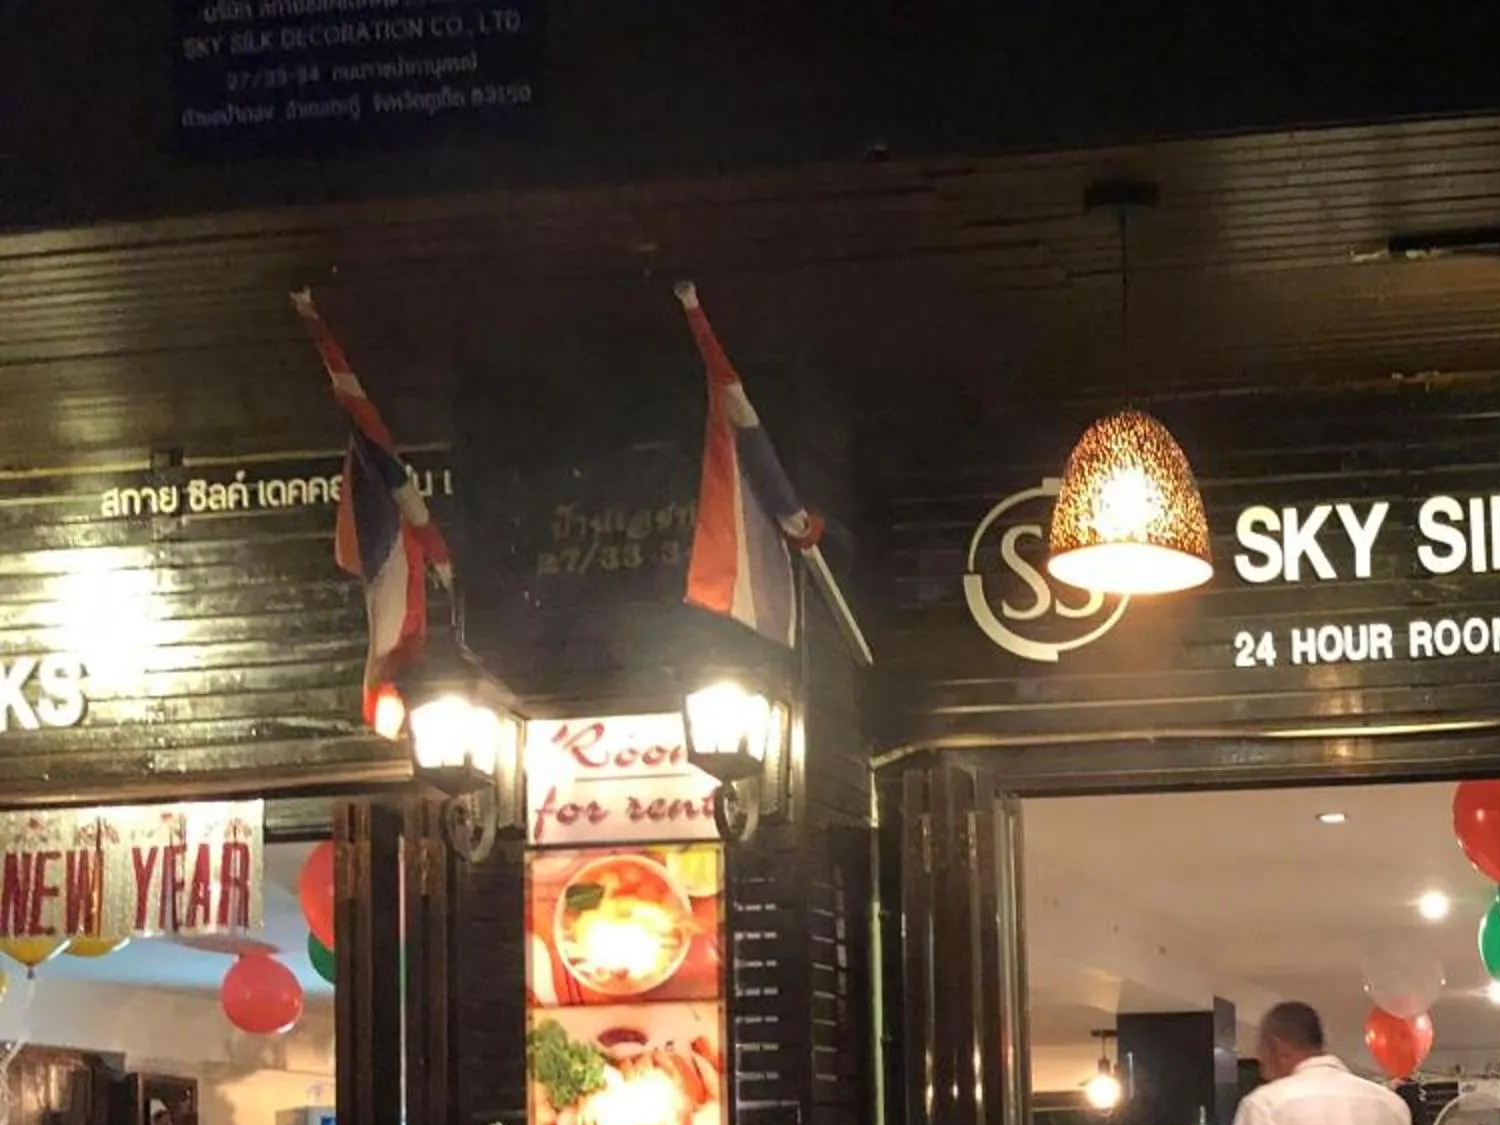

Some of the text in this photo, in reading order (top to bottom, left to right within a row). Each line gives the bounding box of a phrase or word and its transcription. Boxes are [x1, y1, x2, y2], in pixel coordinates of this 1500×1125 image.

[184, 34, 221, 60] SKY
[230, 28, 274, 54] SILK
[281, 17, 423, 51] DECORATION
[101, 484, 178, 517] สกาย
[1233, 502, 1389, 584] SKY
[1234, 631, 1276, 667] 24
[1291, 623, 1392, 666] HOUR
[534, 785, 609, 843] for
[1, 841, 251, 938] NEW YEAR
